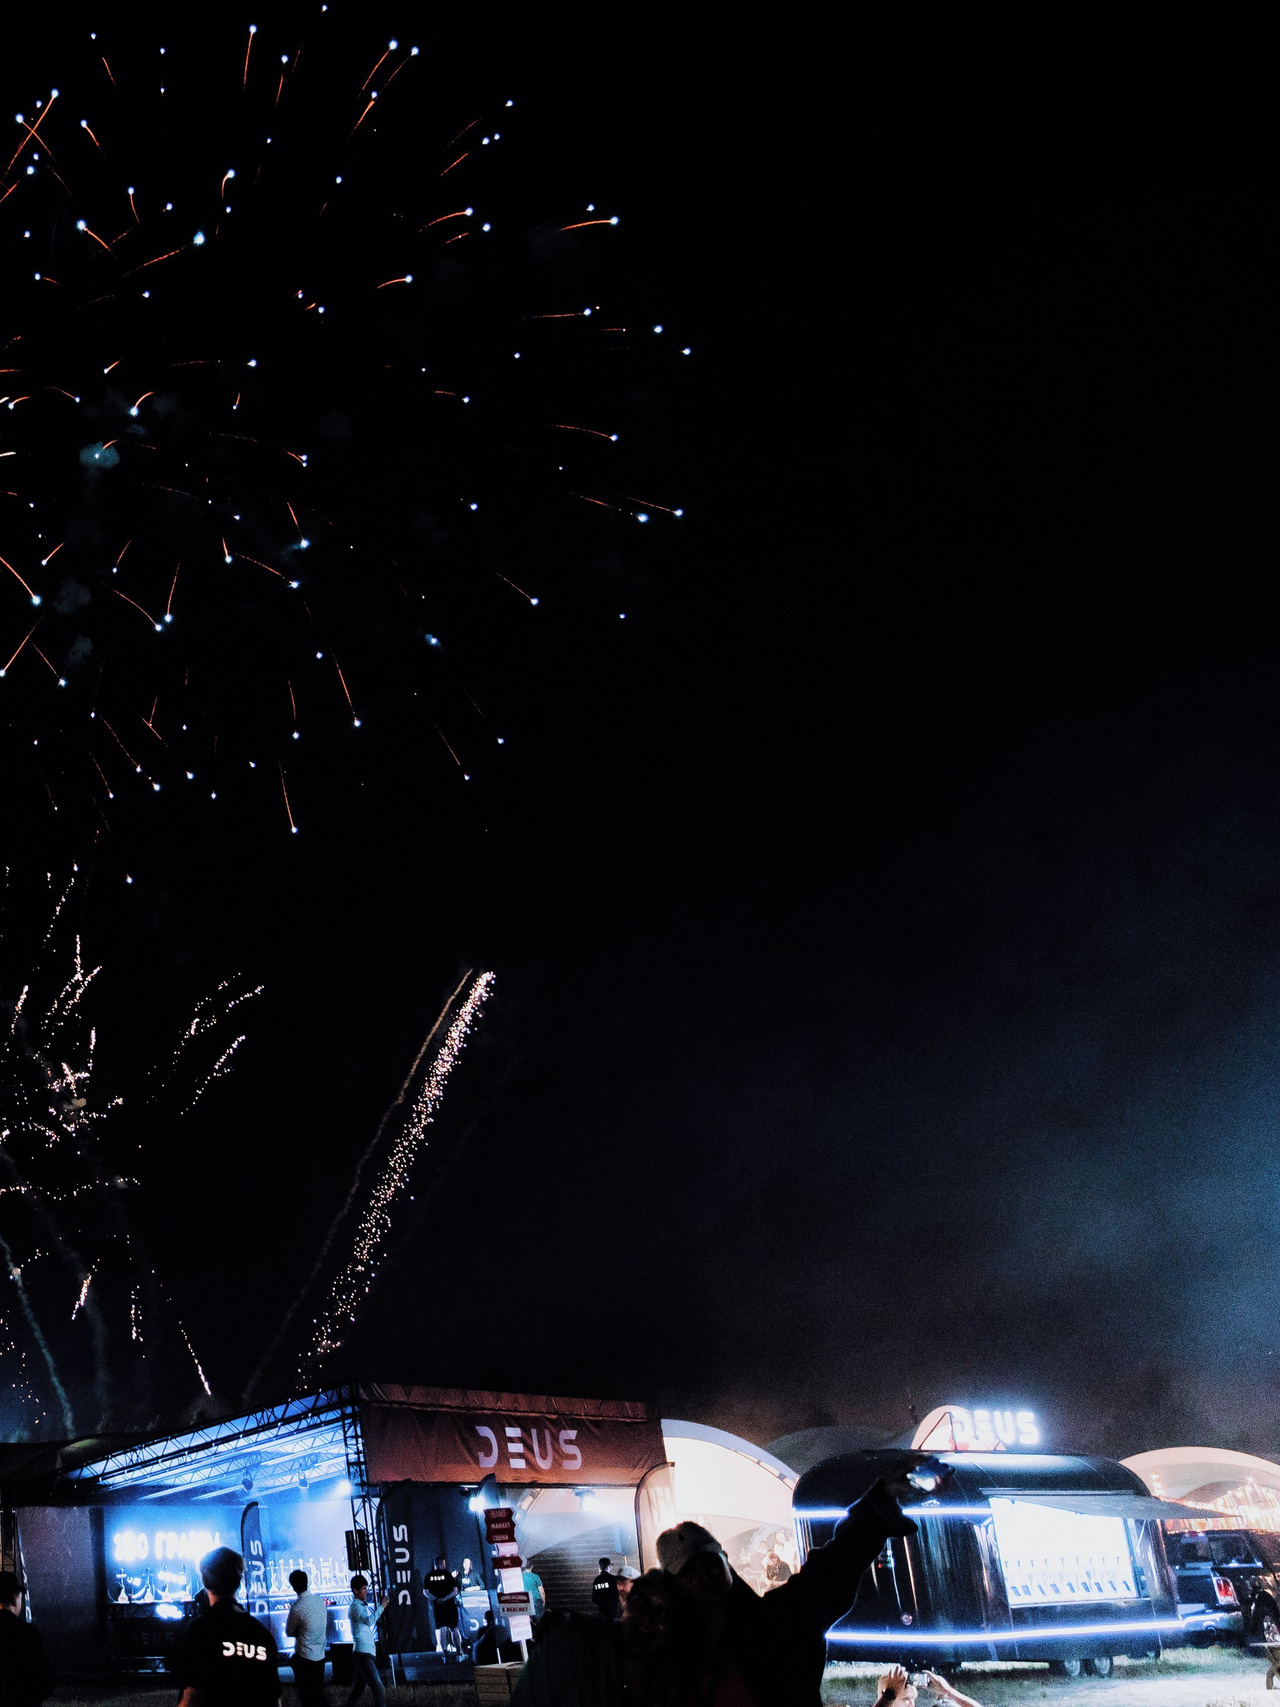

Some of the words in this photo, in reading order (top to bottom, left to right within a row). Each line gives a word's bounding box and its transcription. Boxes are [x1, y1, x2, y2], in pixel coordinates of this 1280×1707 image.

[952, 1409, 1040, 1445] DEUS
[475, 1425, 582, 1470] DEUS
[393, 1524, 412, 1606] DEUS
[222, 1641, 268, 1661] DEUS
